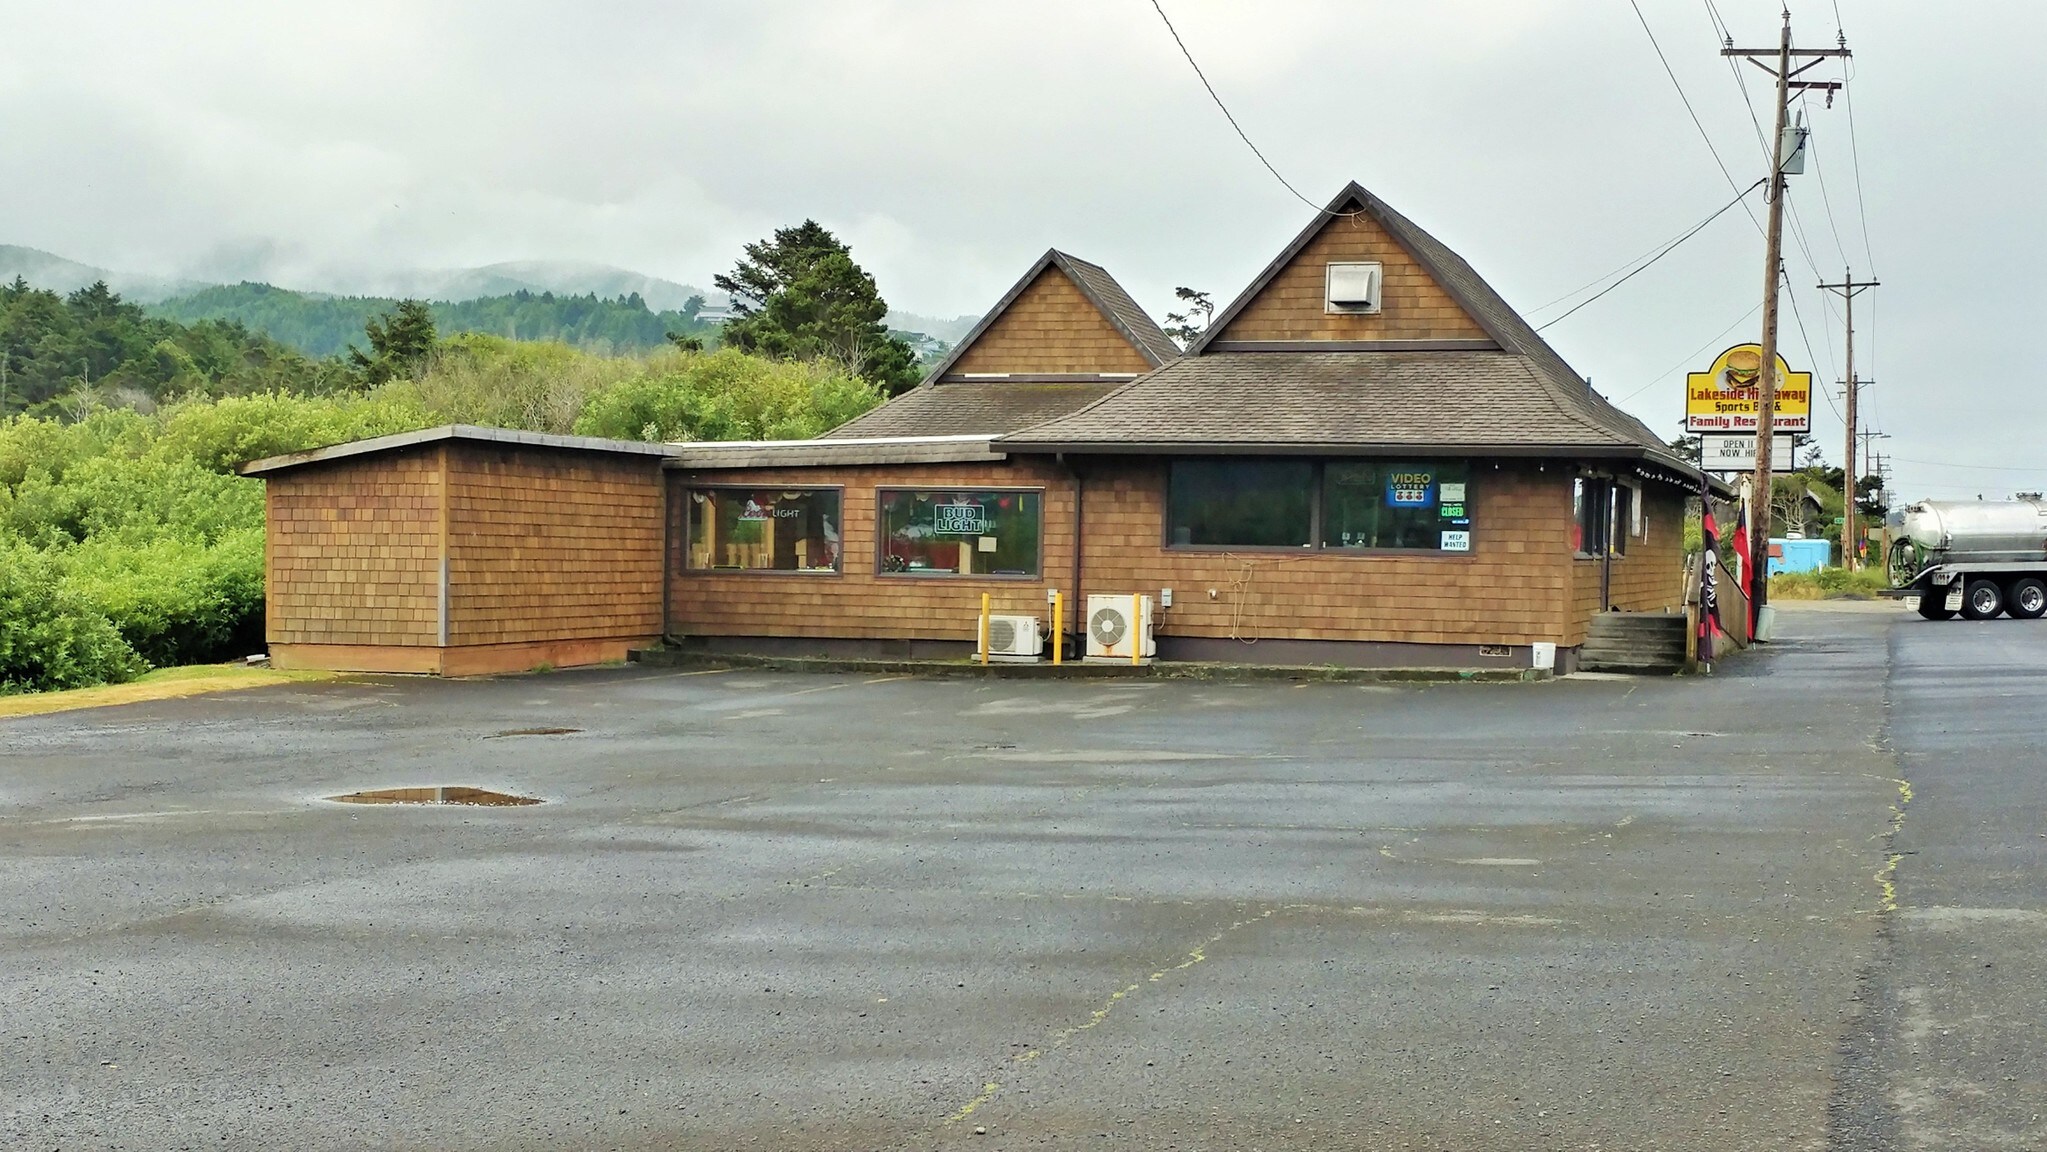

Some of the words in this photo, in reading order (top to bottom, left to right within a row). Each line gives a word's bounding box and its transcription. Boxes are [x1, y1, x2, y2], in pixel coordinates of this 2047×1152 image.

[1691, 388, 1745, 400] Lakeside
[1747, 387, 1806, 403] Hiaway
[1715, 402, 1750, 413] Sports
[1690, 416, 1730, 428] Family
[1734, 416, 1806, 427] Resurant
[1723, 440, 1745, 449] OPEN
[1719, 449, 1741, 458] NOW
[1391, 473, 1431, 483] VIDEO
[772, 509, 800, 518] LIGHT
[943, 507, 976, 520] BUD
[937, 518, 982, 531] LIGHT
